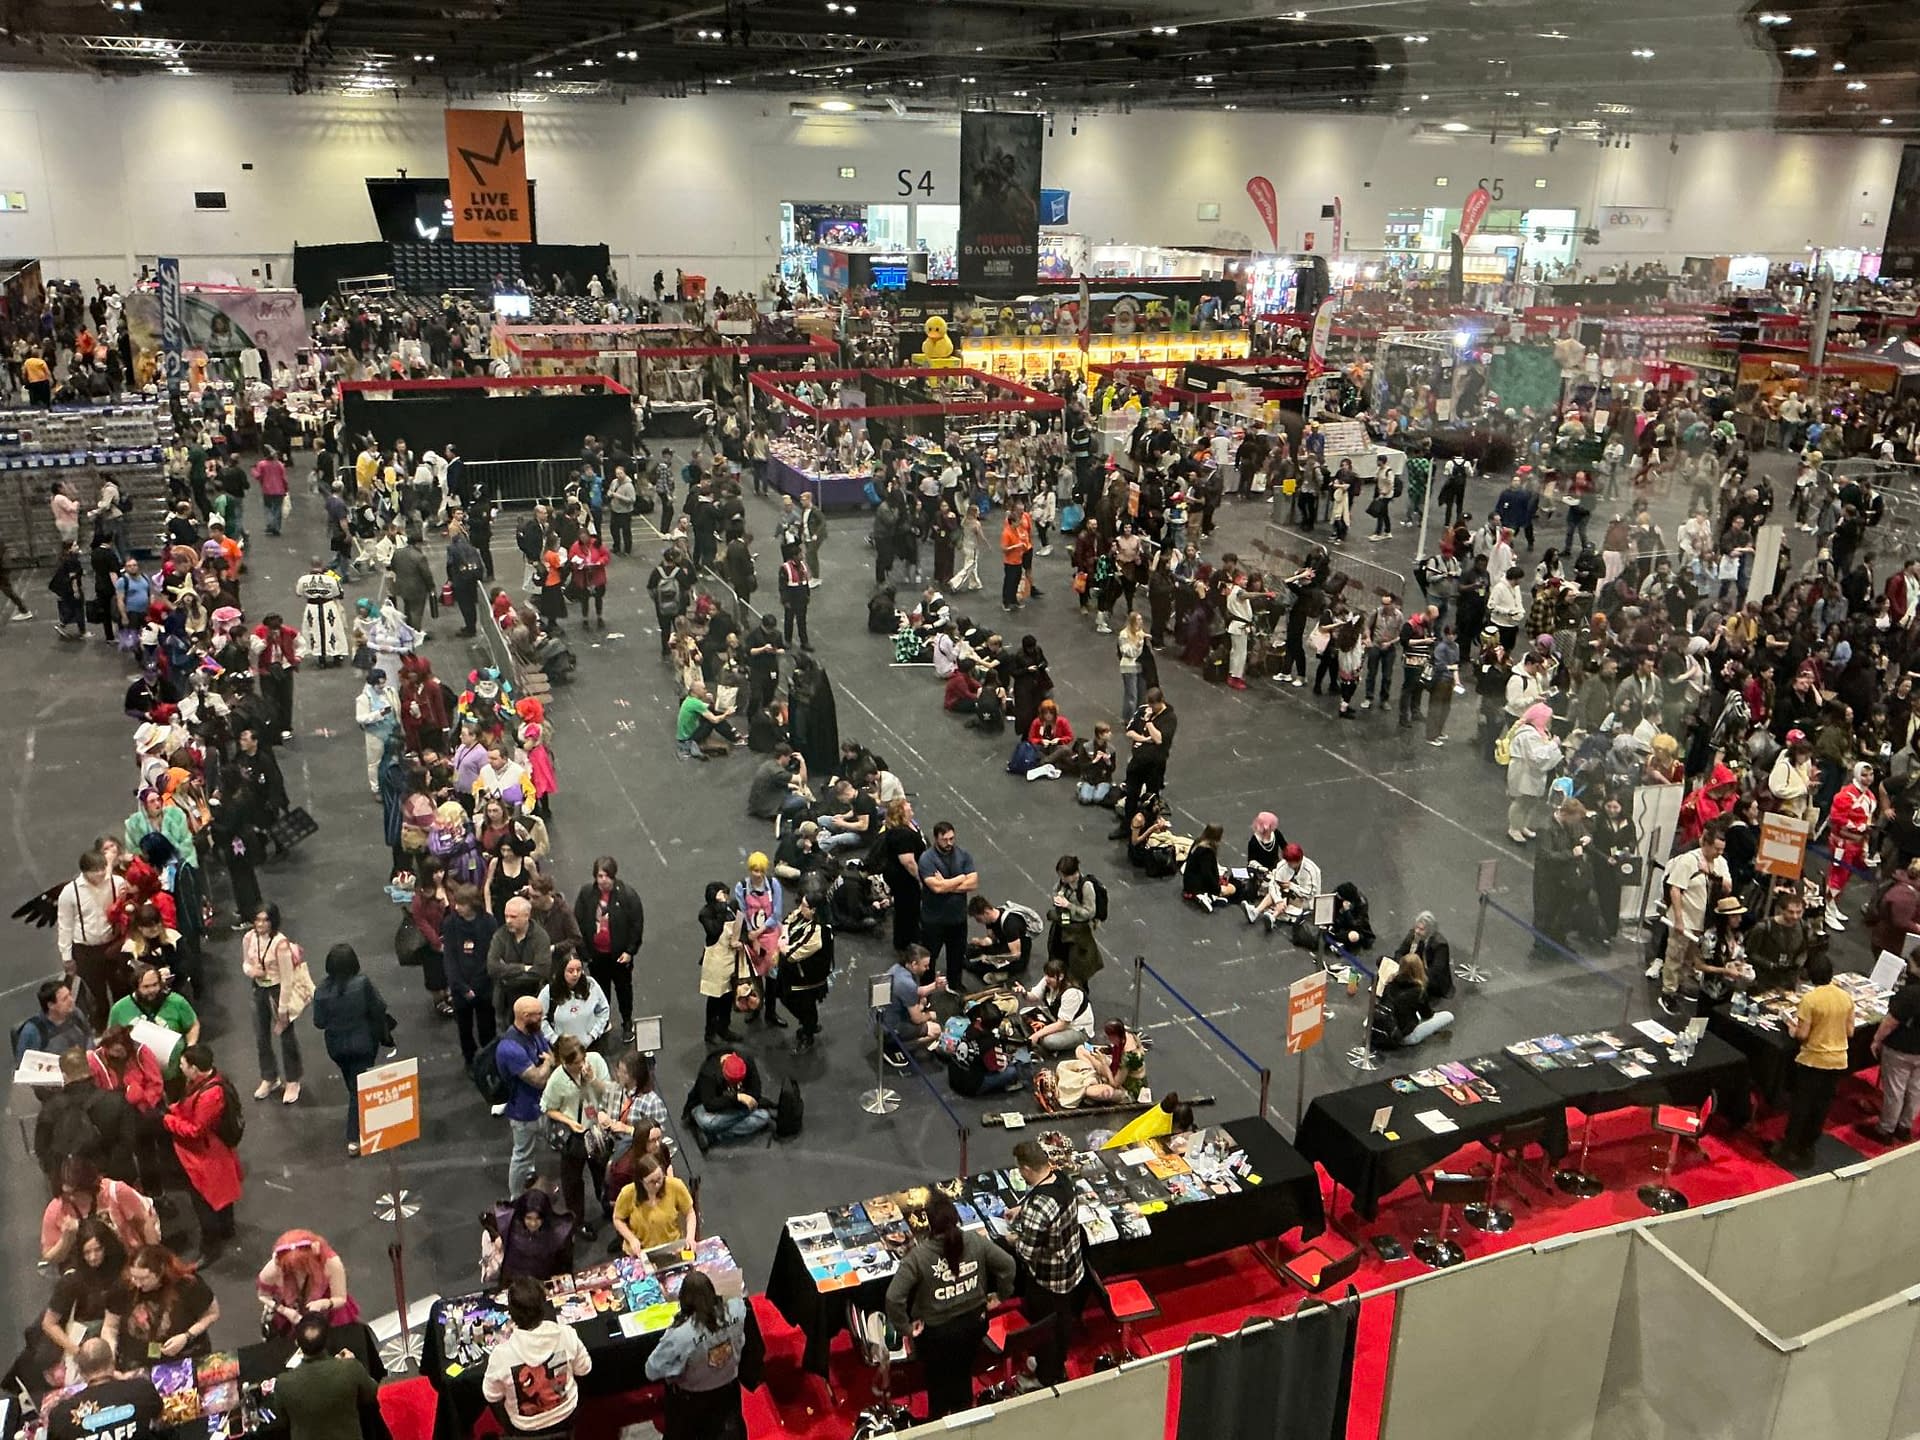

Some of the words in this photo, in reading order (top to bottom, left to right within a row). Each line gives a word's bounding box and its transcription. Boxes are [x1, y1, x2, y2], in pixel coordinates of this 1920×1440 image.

[898, 169, 935, 197] S4
[470, 192, 509, 206] LIVE
[463, 208, 519, 221] STAGE
[1609, 211, 1649, 228] ebay
[964, 245, 1033, 255] BADLANDS
[160, 262, 181, 347] Funko
[364, 1090, 384, 1102] VIP
[385, 1081, 412, 1097] LANE
[378, 1091, 400, 1105] FOR
[934, 1274, 979, 1300] CREW
[75, 1421, 137, 1440] AFF
